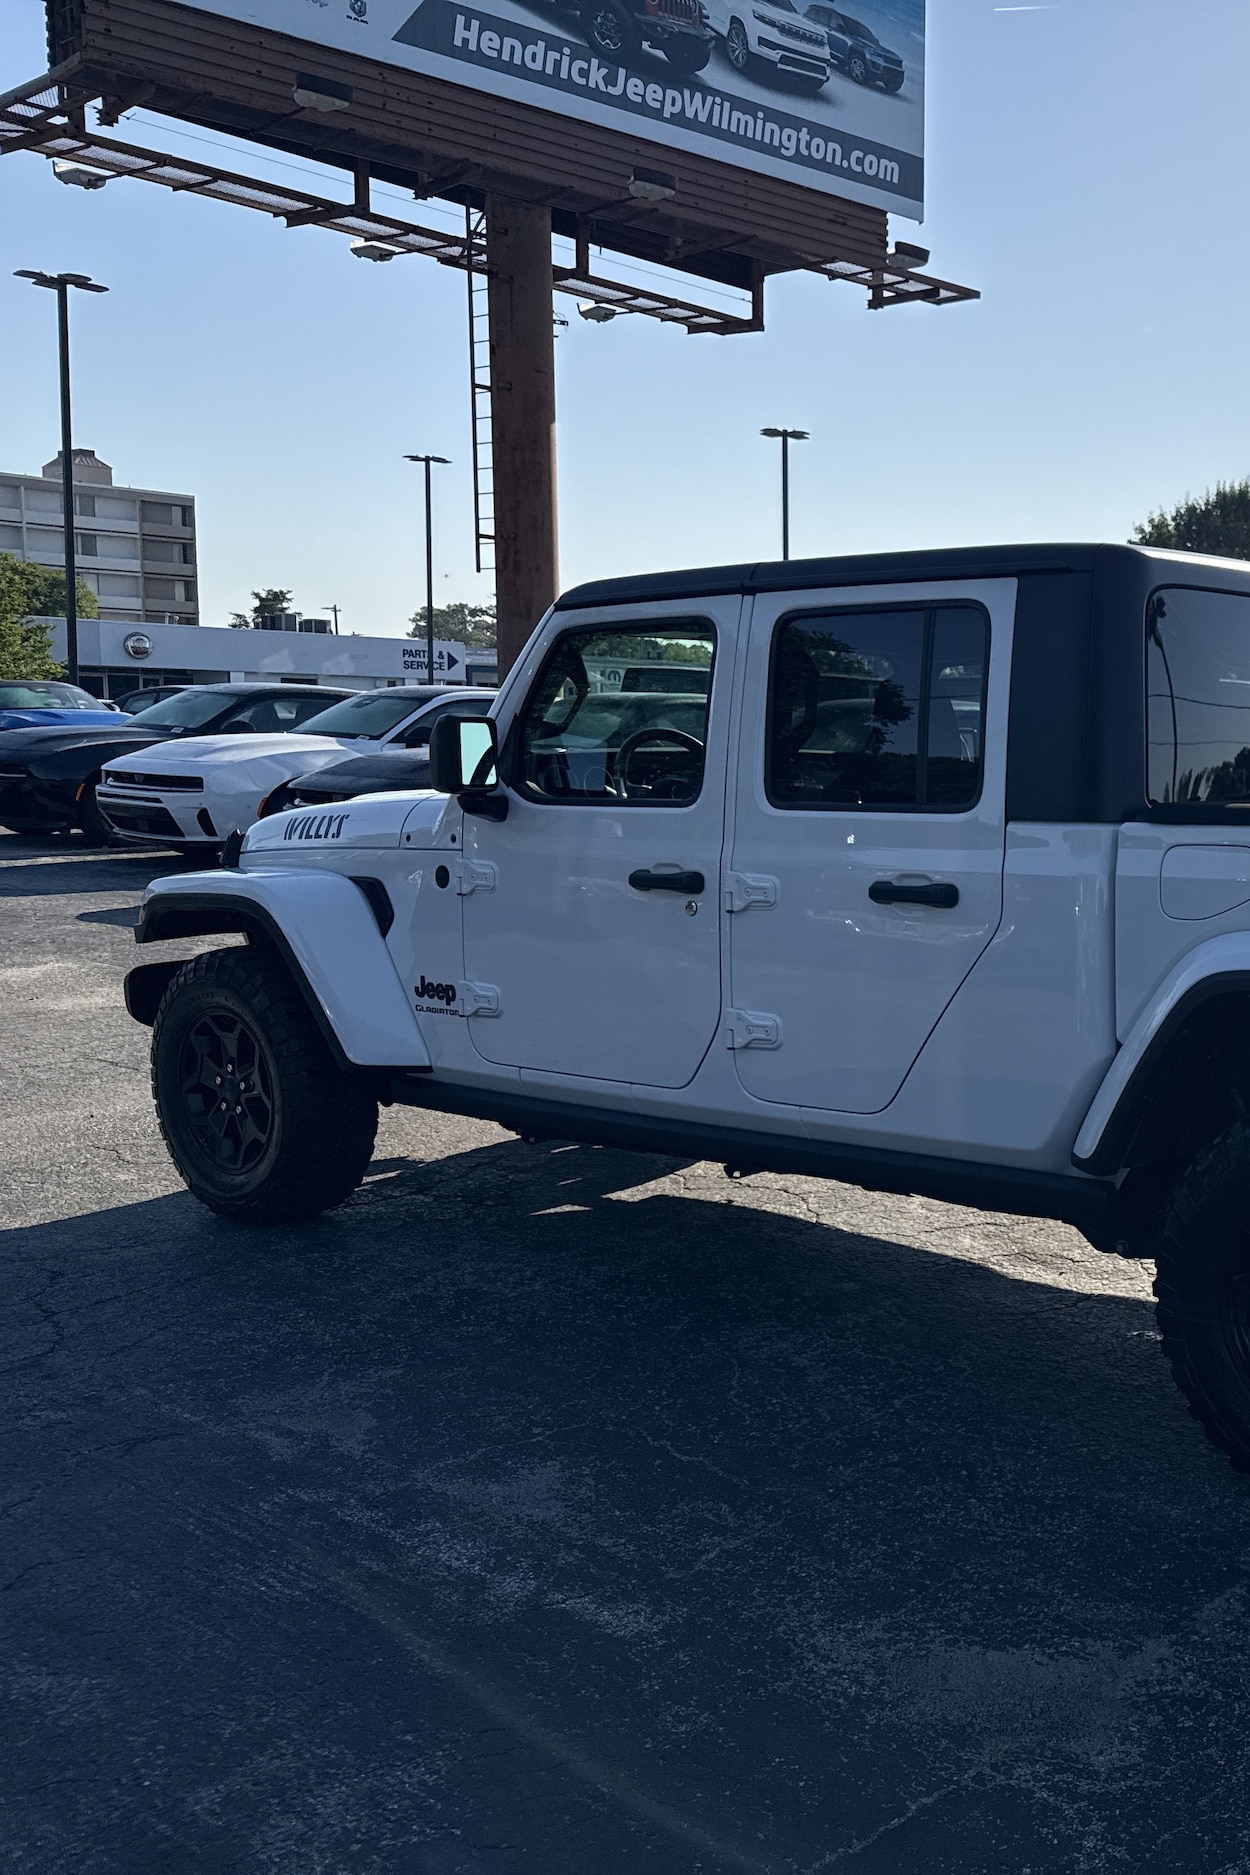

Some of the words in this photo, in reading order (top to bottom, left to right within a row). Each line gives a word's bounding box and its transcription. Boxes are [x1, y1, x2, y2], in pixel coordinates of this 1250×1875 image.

[452, 13, 900, 184] HendrickJeepWilmington.com
[402, 649, 430, 659] PART
[437, 650, 445, 660] &
[403, 660, 446, 671] SERVCE
[283, 814, 351, 840] WILLYS
[414, 975, 457, 1006] Jeep
[415, 1004, 460, 1016] GLADIATOR
